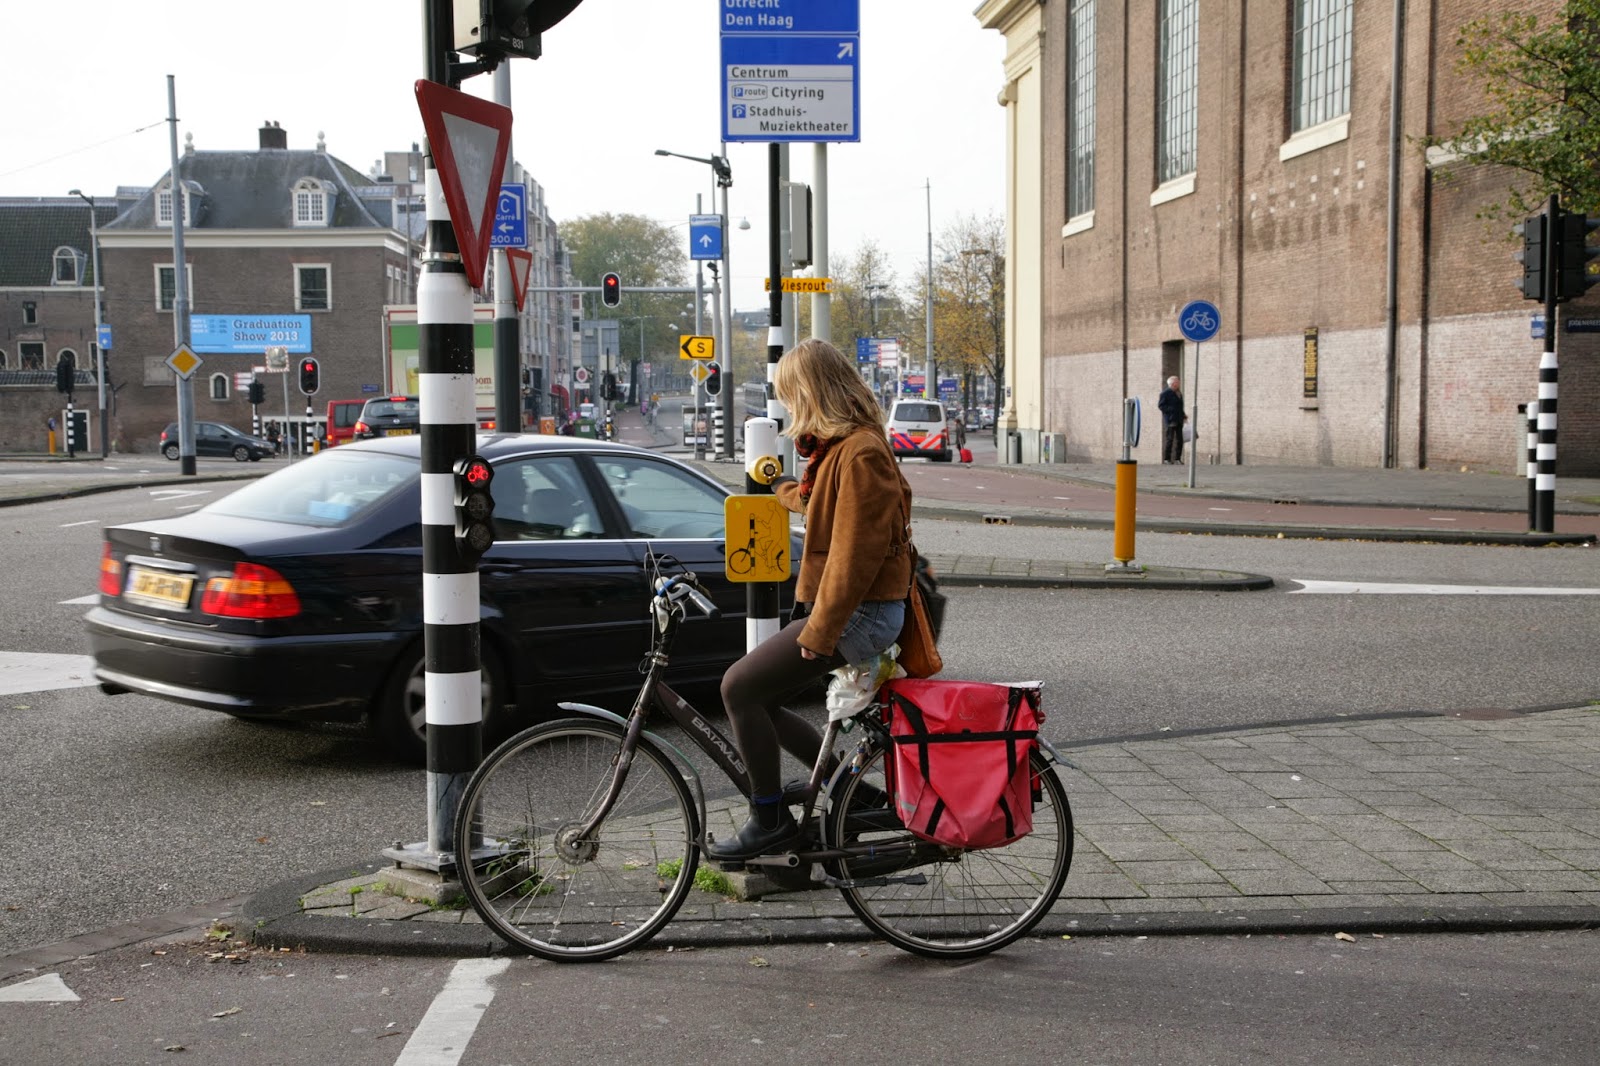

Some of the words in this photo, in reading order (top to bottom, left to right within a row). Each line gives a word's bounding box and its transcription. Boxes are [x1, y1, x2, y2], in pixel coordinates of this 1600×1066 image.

[726, 0, 780, 8] Utrecht
[726, 13, 753, 26] Den
[758, 13, 793, 29] Haag
[512, 37, 524, 50] 831
[731, 67, 789, 78] Centrum
[744, 88, 766, 96] route
[771, 86, 824, 100] Cityring
[750, 105, 807, 117] Stadhuis-
[759, 121, 848, 132] Muziektheater
[500, 198, 510, 213] C
[491, 235, 511, 244] 500
[233, 319, 302, 329] Graduation
[233, 331, 267, 341] Show
[270, 331, 298, 341] 2013
[696, 342, 705, 354] S
[692, 716, 747, 775] BATAVUS
